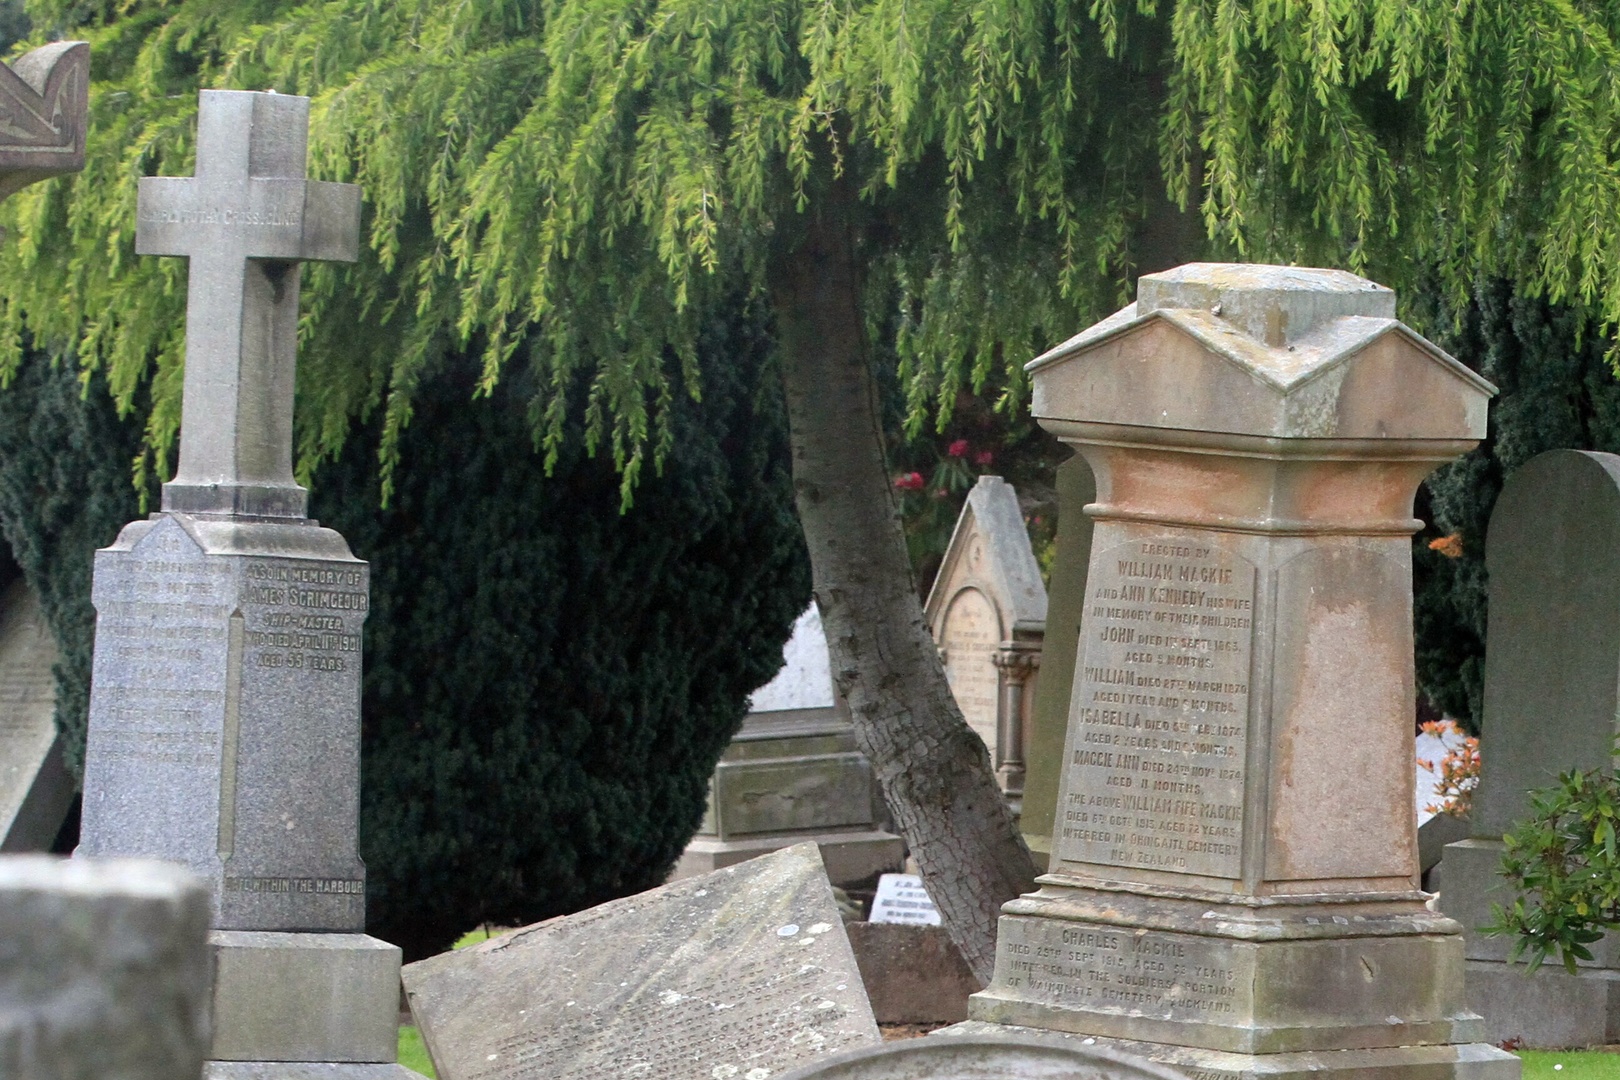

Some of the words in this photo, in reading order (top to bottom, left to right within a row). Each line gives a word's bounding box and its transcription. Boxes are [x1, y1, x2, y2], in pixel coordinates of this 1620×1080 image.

[1142, 544, 1190, 557] ERECTED
[1195, 549, 1210, 558] BY
[246, 566, 274, 580] ALSO
[275, 567, 288, 581] IN
[292, 569, 343, 584] MEMORY
[347, 572, 360, 585] OF
[1118, 560, 1173, 580] WILLIAM
[1179, 566, 1232, 584] MACKIE
[240, 586, 284, 605] JAMES
[290, 586, 367, 611] SCRIMGEOUR
[1096, 588, 1117, 599] AND
[1121, 585, 1145, 601] ANN
[1150, 587, 1205, 607] KENNEDY
[1207, 598, 1223, 607] HIS
[1225, 599, 1250, 609] WIFE
[1093, 607, 1104, 616] IN
[1106, 608, 1151, 621] MEMORY
[1154, 612, 1166, 622] OF
[1169, 613, 1199, 625] THEIR
[1202, 616, 1250, 628] CHILDREN
[246, 631, 266, 646] WHO
[268, 633, 289, 647] DIED
[292, 633, 320, 649] APRIL
[340, 636, 360, 652] 1901
[1101, 627, 1135, 643] JOHN
[1138, 635, 1162, 646] DIED
[258, 654, 282, 667] AGED
[288, 653, 303, 668] 55
[1085, 667, 1134, 686] WILLIAM
[1080, 708, 1141, 729] ISABELLA
[1107, 776, 1131, 787] AGED
[1122, 794, 1172, 814] WILLIAM
[1174, 800, 1197, 816] FIFE
[1201, 803, 1242, 821] MACKIE
[1111, 850, 1133, 862] NEW
[253, 878, 290, 892] WITHIN
[294, 879, 312, 892] THE
[316, 880, 363, 894] HARBOUR
[1062, 930, 1118, 949] CHARLES
[1133, 938, 1184, 958] MACKIE
[1135, 960, 1164, 972] AGED
